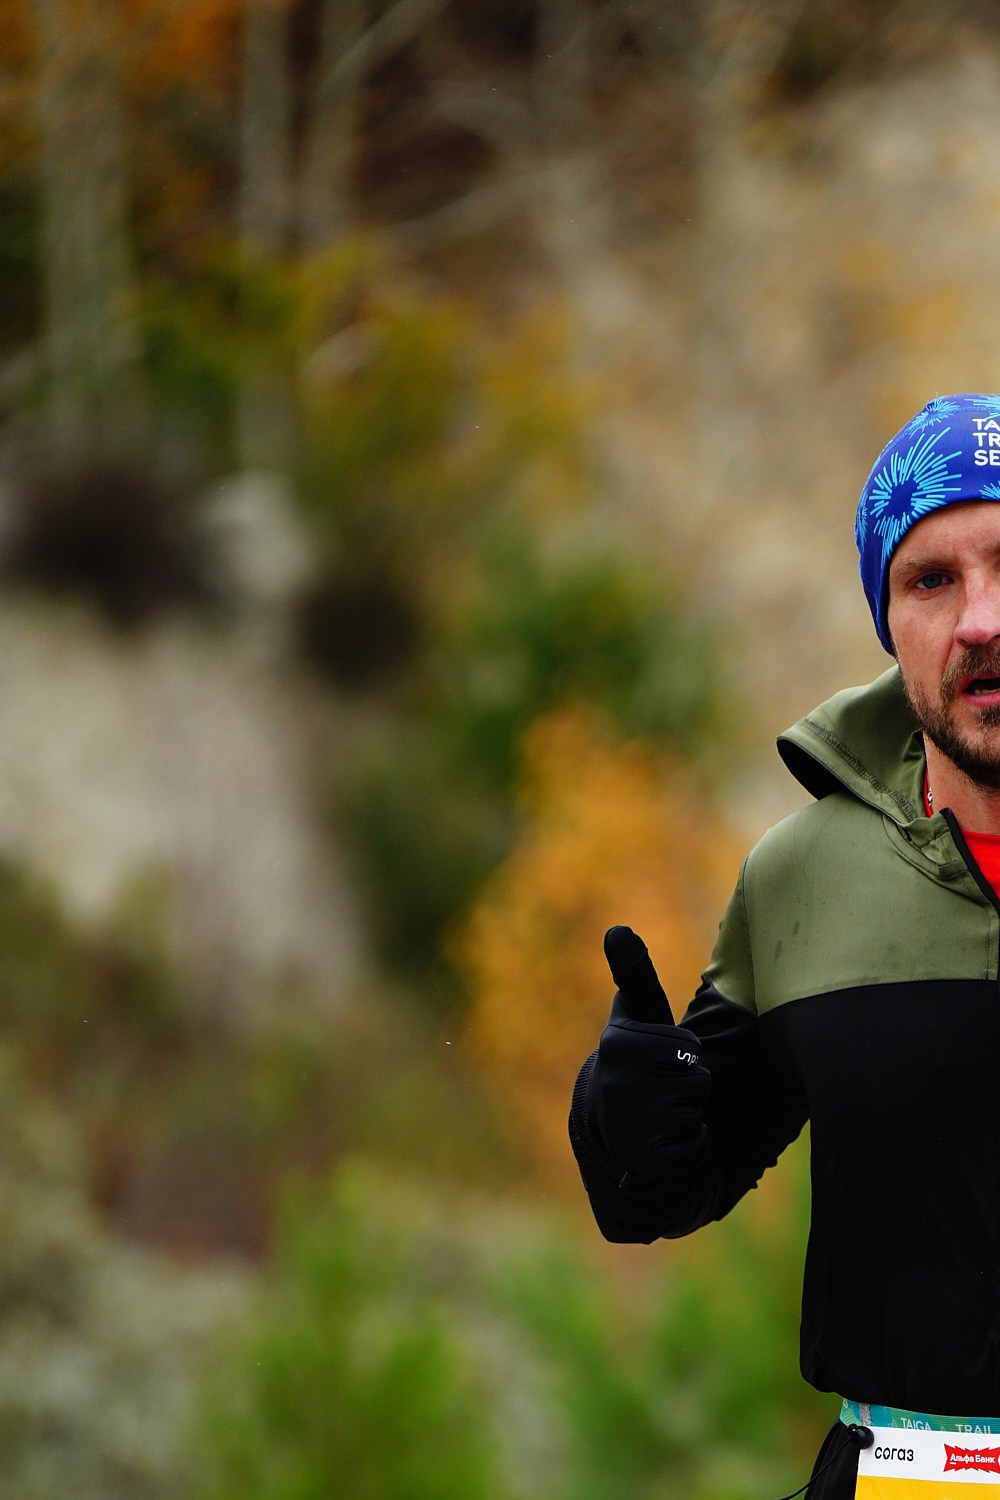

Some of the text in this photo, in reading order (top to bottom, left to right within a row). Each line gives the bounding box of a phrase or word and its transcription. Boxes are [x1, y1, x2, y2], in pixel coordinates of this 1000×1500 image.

[900, 1417, 932, 1431] TAIGA
[954, 1424, 992, 1434] TRAIL
[950, 1453, 996, 1464] Альфа Банк
